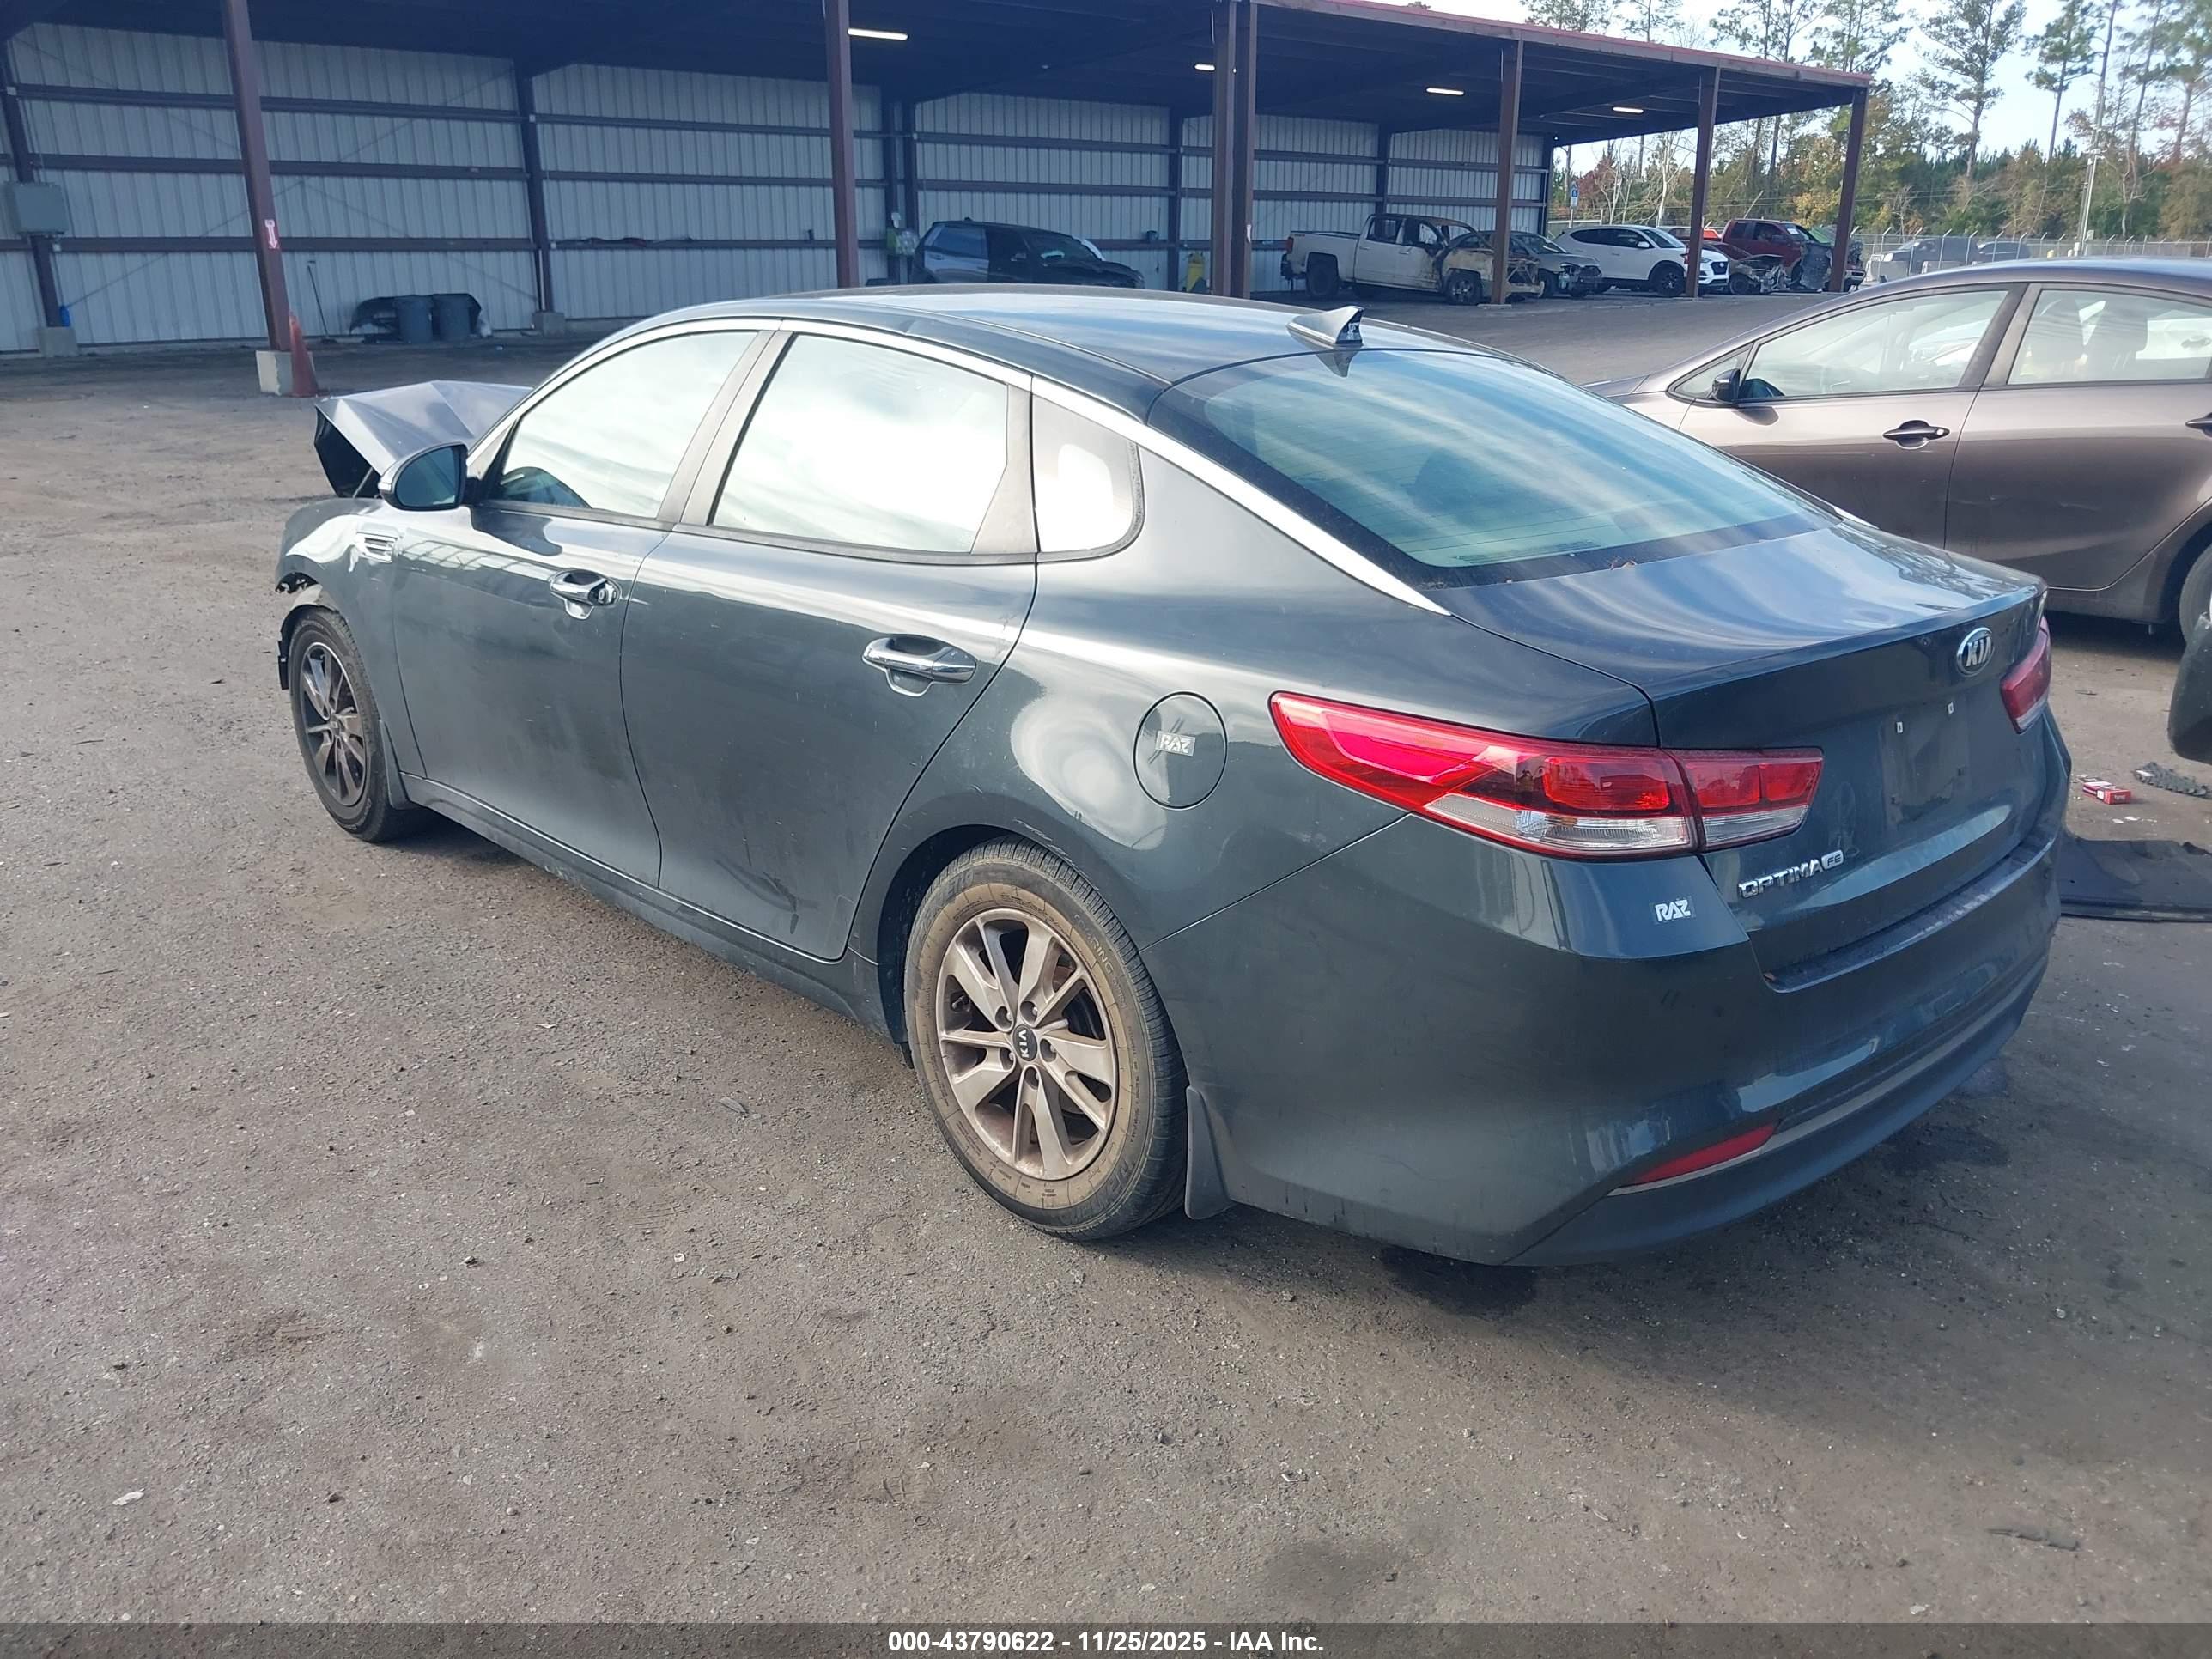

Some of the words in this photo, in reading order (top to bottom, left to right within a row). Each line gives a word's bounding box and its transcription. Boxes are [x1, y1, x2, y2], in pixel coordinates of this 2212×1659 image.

[1966, 636, 1992, 666] KIA
[1159, 733, 1191, 754] RAZ
[1738, 859, 1823, 897] OPTIMA
[1826, 852, 1843, 868] FE
[1655, 899, 1692, 921] RAZ
[1018, 1030, 1030, 1058] KIA
